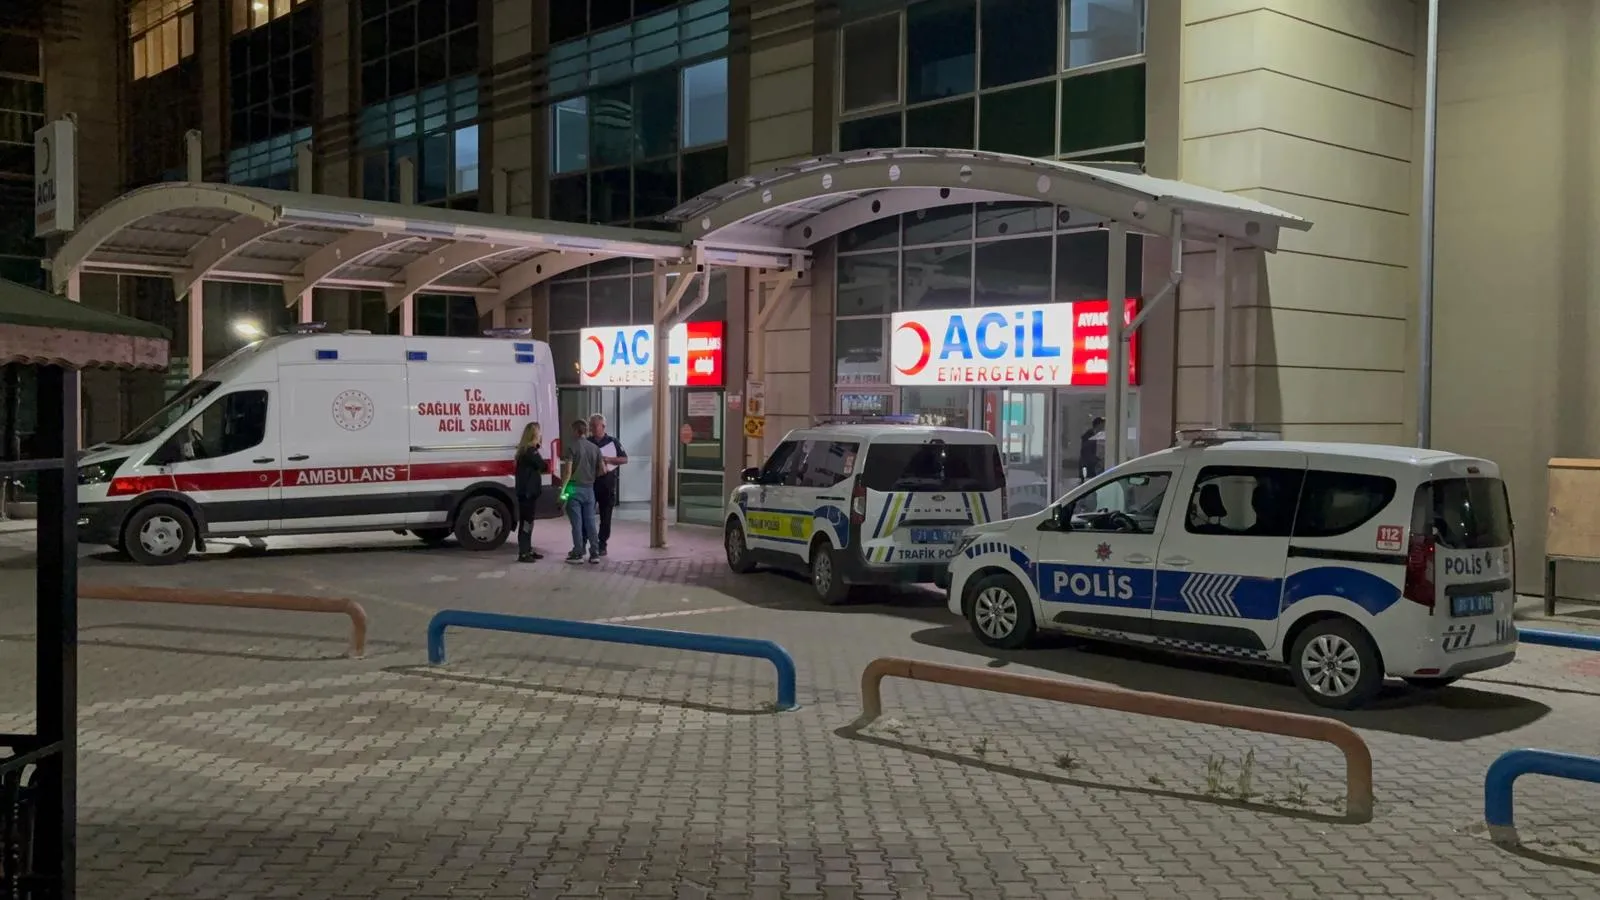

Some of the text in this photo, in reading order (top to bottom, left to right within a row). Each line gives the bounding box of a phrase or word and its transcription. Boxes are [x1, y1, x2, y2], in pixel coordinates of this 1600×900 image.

[938, 365, 1060, 382] EMERGENCY
[464, 389, 485, 402] T.C.
[418, 402, 530, 416] SAĞLIK BAKANLIĞI
[438, 418, 512, 432] ACİL SAĞLIK
[296, 467, 396, 485] AMBULANS
[1381, 528, 1400, 540] 112
[899, 547, 935, 559] TRAFİK
[1445, 554, 1482, 575] POLİS
[1053, 569, 1133, 600] POLİS
